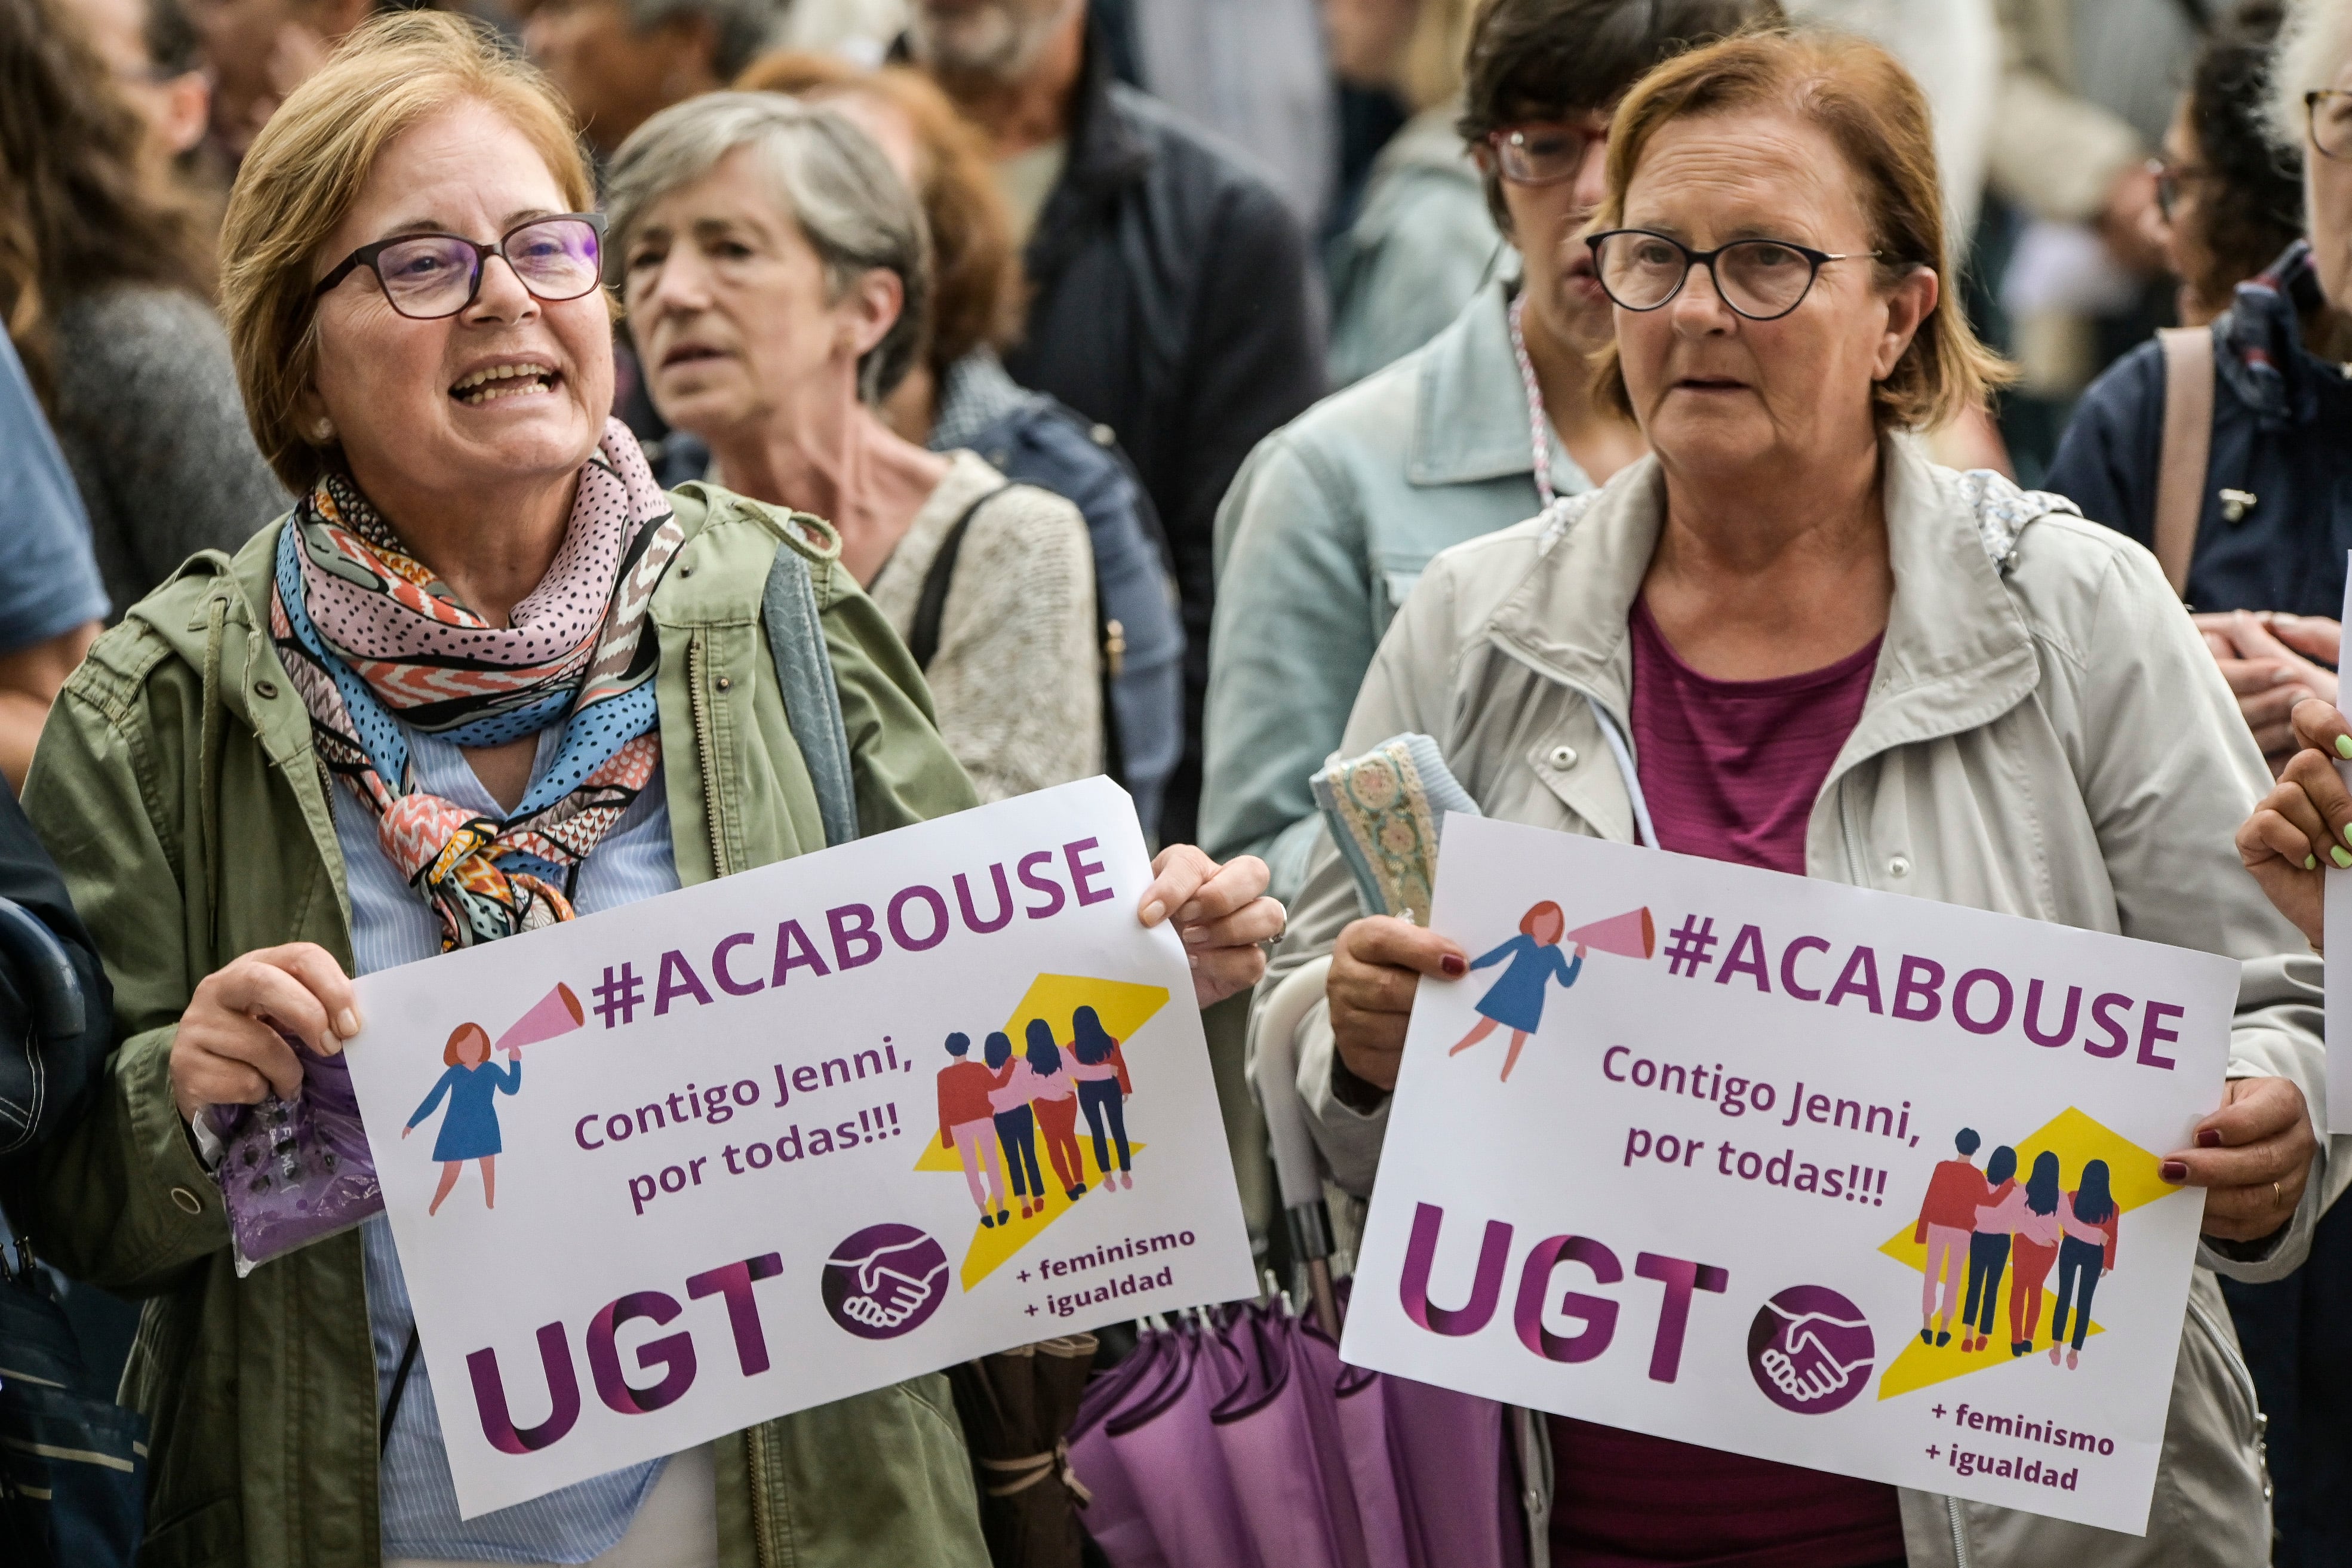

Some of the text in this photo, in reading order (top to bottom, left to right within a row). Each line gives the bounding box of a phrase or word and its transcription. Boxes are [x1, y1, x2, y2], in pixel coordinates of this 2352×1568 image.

[592, 837, 1115, 1029] #ACABOUSE
[1664, 913, 2185, 1071] #ACABOUSE
[574, 1035, 912, 1151] Contigo Jenni,
[1602, 1045, 1920, 1148] Contigo Jenni,
[628, 1102, 902, 1216] por todas!!!
[1624, 1127, 1889, 1207] por todas!!!
[1017, 1230, 1195, 1283] + feminismo
[1024, 1266, 1173, 1318] + igualdad
[1399, 1201, 1730, 1385] UGT
[465, 1252, 784, 1455] UGT
[1925, 1441, 2079, 1492] + igualdad
[1932, 1403, 2114, 1456] + feminismo
